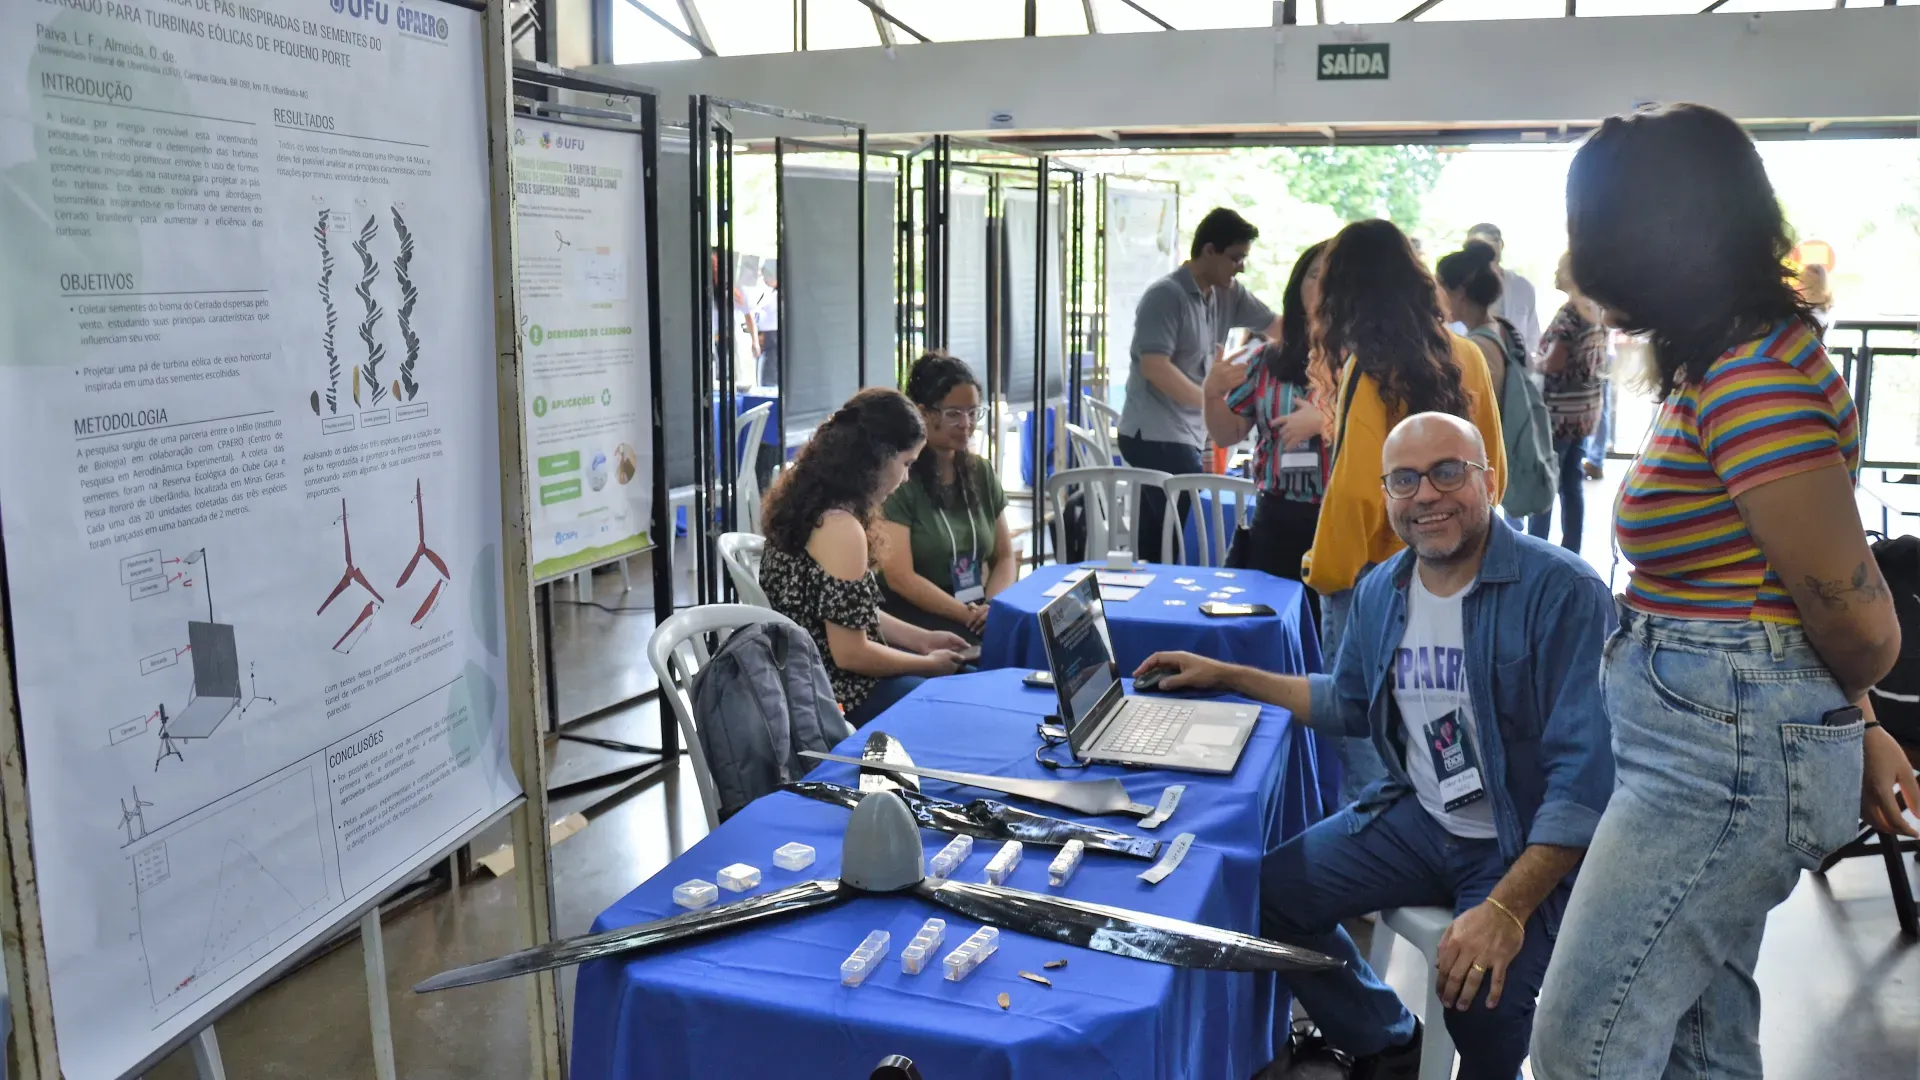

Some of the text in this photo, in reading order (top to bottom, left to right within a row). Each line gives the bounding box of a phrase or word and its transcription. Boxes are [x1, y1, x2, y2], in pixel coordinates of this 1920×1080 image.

[348, 0, 389, 25] UFU
[37, 0, 351, 68] RADO PARA TURBINAS EÓLICAS DE PEQUENO PORTE
[239, 6, 301, 32] INSPIRADAS
[303, 21, 318, 36] EM
[320, 25, 368, 48] SEMENTES
[370, 37, 381, 51] DO
[104, 37, 147, 58] Almeida,
[1322, 47, 1386, 75] SAÍDA
[41, 71, 133, 103] INTRODUÇÃO
[274, 108, 335, 131] RESULTADOS
[564, 138, 585, 151] UFU
[60, 272, 134, 291] OBJETIVOS
[109, 303, 146, 313] sementes
[148, 302, 157, 311] do
[184, 301, 193, 310] do
[194, 300, 221, 309] Cerrado
[223, 299, 253, 311] dispersas
[255, 297, 268, 310] pelo
[108, 317, 149, 328] estudando
[257, 313, 269, 323] que
[547, 328, 589, 340] DERIVADOS
[590, 328, 599, 337] DE
[81, 334, 127, 345] influenciam
[84, 365, 115, 378] Projetar
[139, 362, 148, 374] pá
[151, 361, 160, 370] de
[163, 359, 188, 369] turbina
[192, 356, 211, 367] eólica
[213, 355, 222, 364] de
[240, 351, 271, 362] horizontal
[85, 380, 121, 394] inspirada
[156, 376, 169, 385] das
[170, 372, 204, 383] sementes
[551, 392, 596, 410] APLICAÇÕES
[74, 408, 168, 436] METODOLOGIA
[77, 449, 82, 458] A
[86, 445, 119, 460] pesquisa
[122, 440, 145, 452] surgiu
[149, 438, 157, 447] de
[180, 430, 208, 445] parceria
[211, 427, 227, 437] entre
[78, 464, 88, 473] de
[149, 446, 193, 460] colaboração
[218, 437, 244, 449] CPAERO
[275, 432, 283, 440] de
[80, 476, 114, 489] Pesquisa
[133, 464, 183, 479] Aerodinâmica
[241, 450, 246, 459] A
[248, 447, 267, 458] coleta
[274, 445, 284, 454] das
[82, 490, 119, 504] sementes
[123, 486, 144, 495] foram
[163, 477, 190, 488] Reserva
[195, 469, 226, 482] Ecológica
[230, 466, 238, 475] do
[242, 462, 260, 473] Clube
[264, 460, 278, 470] Caça
[85, 510, 105, 519] Pesca
[137, 499, 146, 508] de
[194, 482, 227, 496] localizada
[244, 476, 262, 486] Minas
[87, 483, 287, 535] Cada uma das 20 unidades coletadas das três espécies
[90, 539, 111, 550] foram
[115, 530, 143, 543] lançadas
[159, 523, 176, 531] uma
[178, 515, 207, 527] bancada
[209, 513, 218, 521] de
[220, 510, 223, 519] 2
[1389, 645, 1465, 692] PAER
[330, 730, 384, 768] CONCLUSÕES
